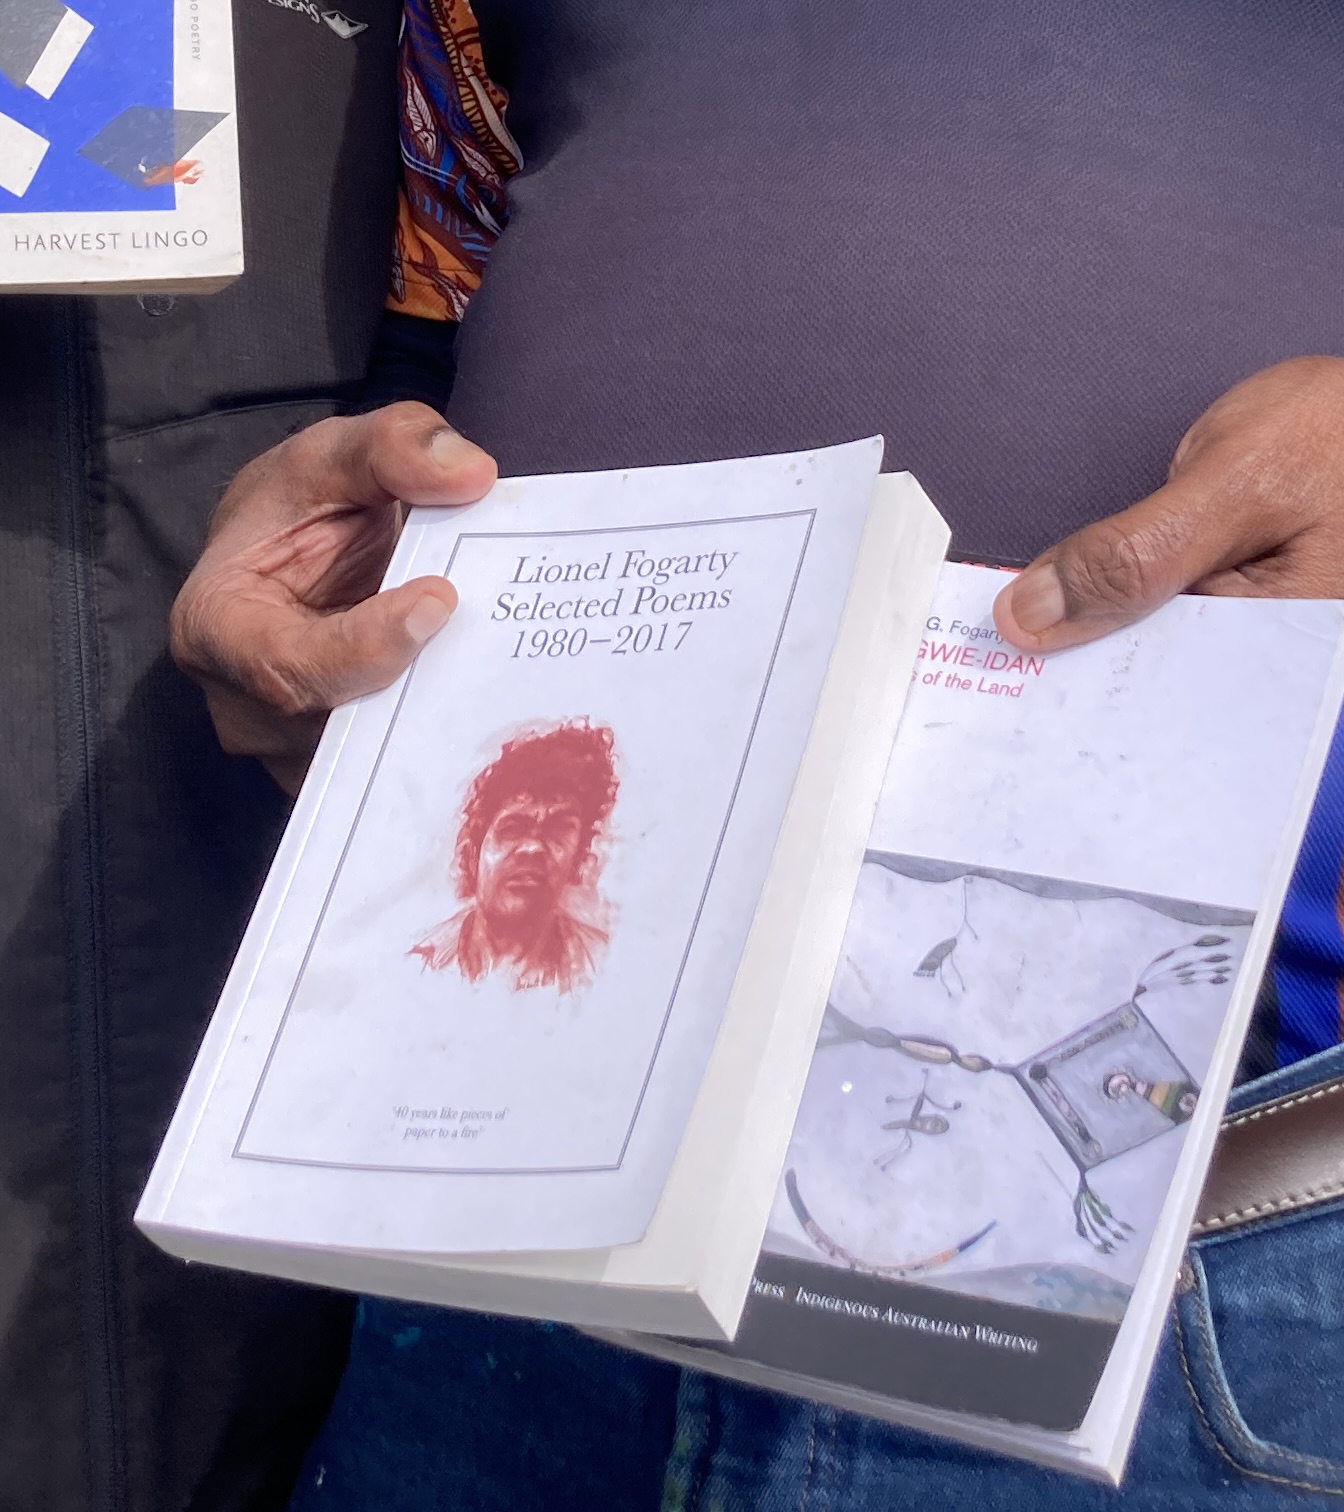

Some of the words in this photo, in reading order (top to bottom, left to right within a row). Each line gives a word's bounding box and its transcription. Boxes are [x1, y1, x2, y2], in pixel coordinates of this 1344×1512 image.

[191, 16, 201, 61] POETRY
[14, 231, 121, 251] HARVEST
[132, 229, 209, 249] LINGO
[509, 551, 613, 584] Lionel
[618, 549, 739, 585] Fogarty
[490, 588, 624, 621] Selected
[629, 586, 733, 616] Poems
[926, 616, 943, 632] G.
[922, 671, 944, 687] of
[945, 672, 973, 691] the
[977, 676, 1025, 698] Land
[410, 1108, 439, 1121] years
[439, 1106, 458, 1120] like
[403, 1125, 436, 1141] paper
[439, 1127, 449, 1138] to
